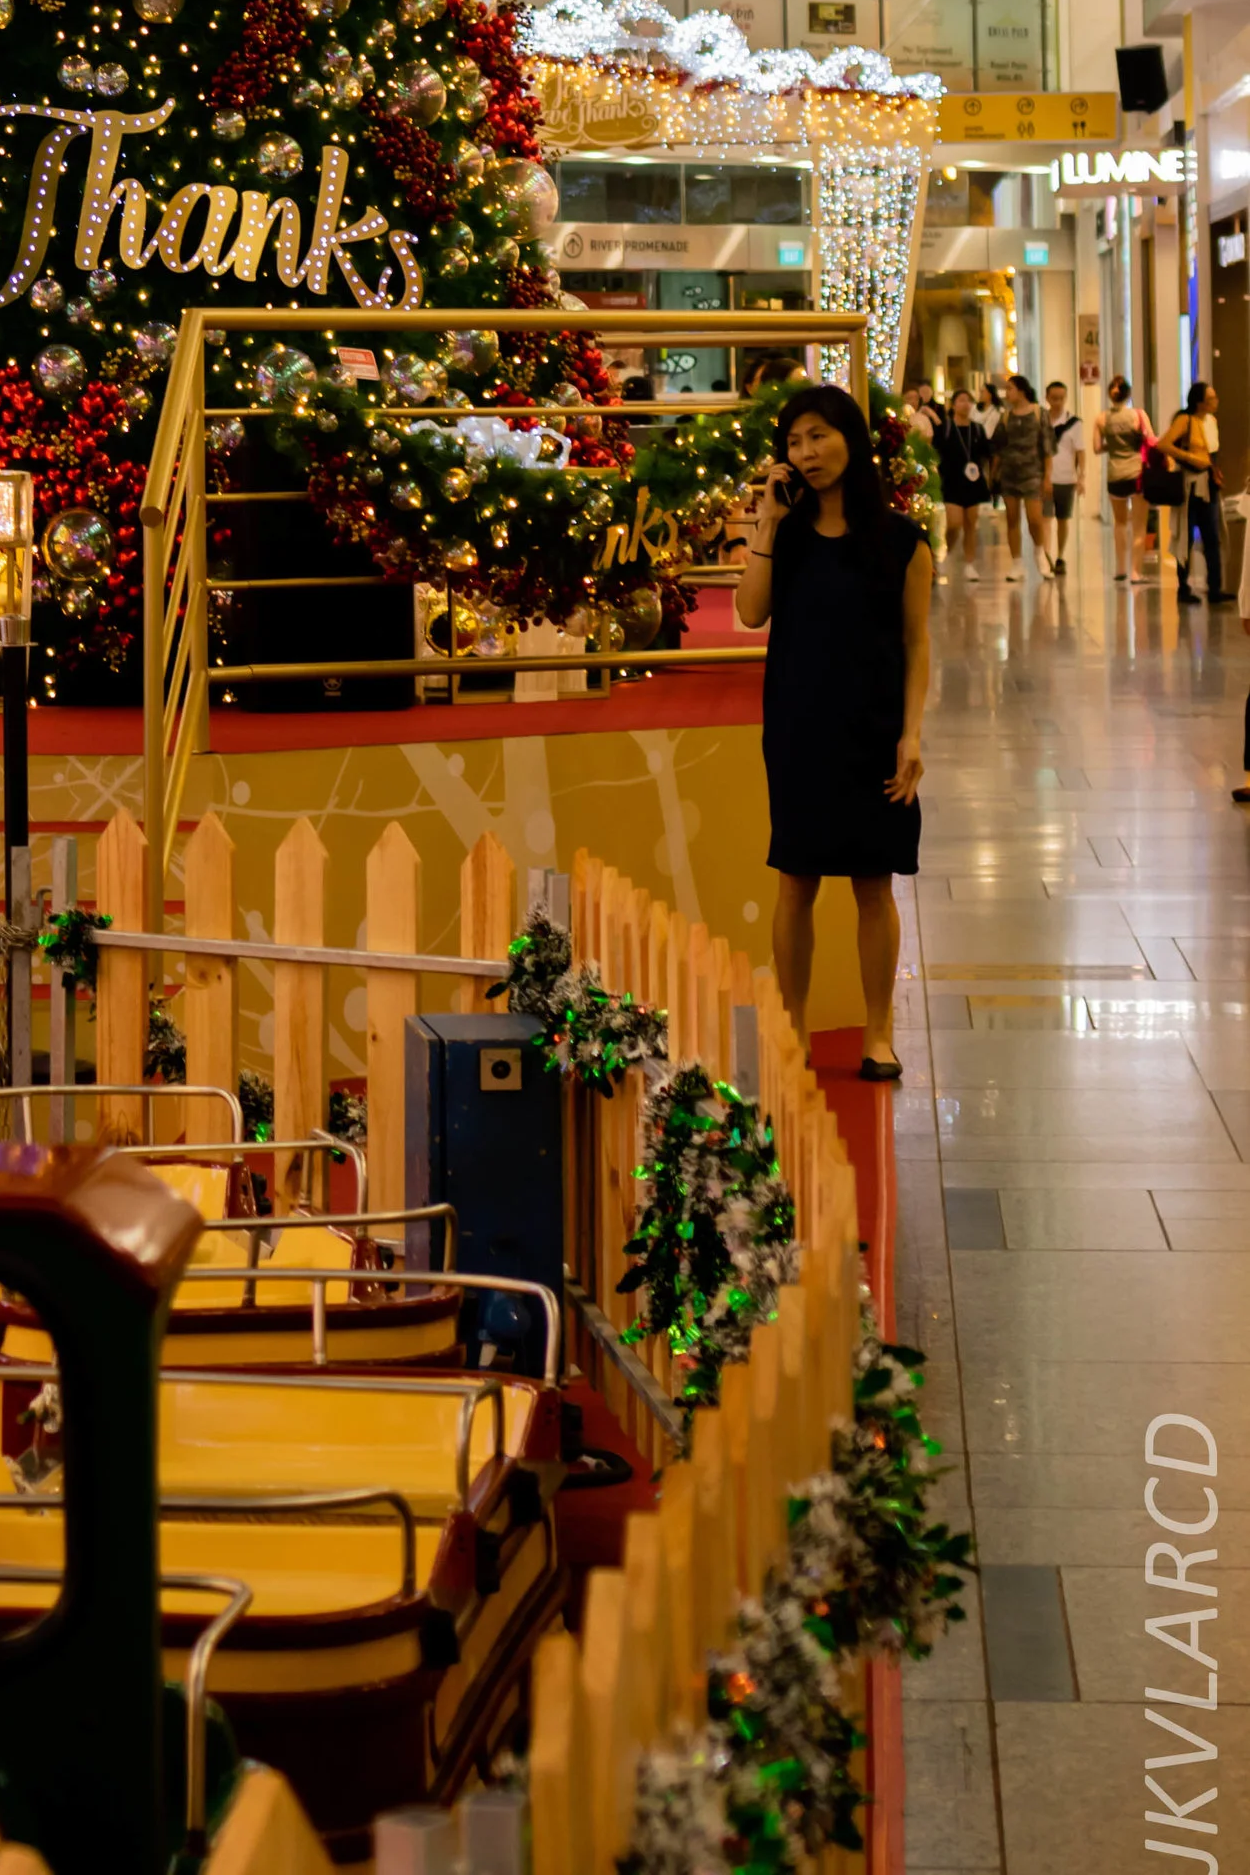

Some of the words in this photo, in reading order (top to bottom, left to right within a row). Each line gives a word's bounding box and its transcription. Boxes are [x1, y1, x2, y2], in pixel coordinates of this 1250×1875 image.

[568, 93, 647, 135] Thanks
[590, 239, 621, 253] RIVER
[624, 239, 690, 253] PROMENADE
